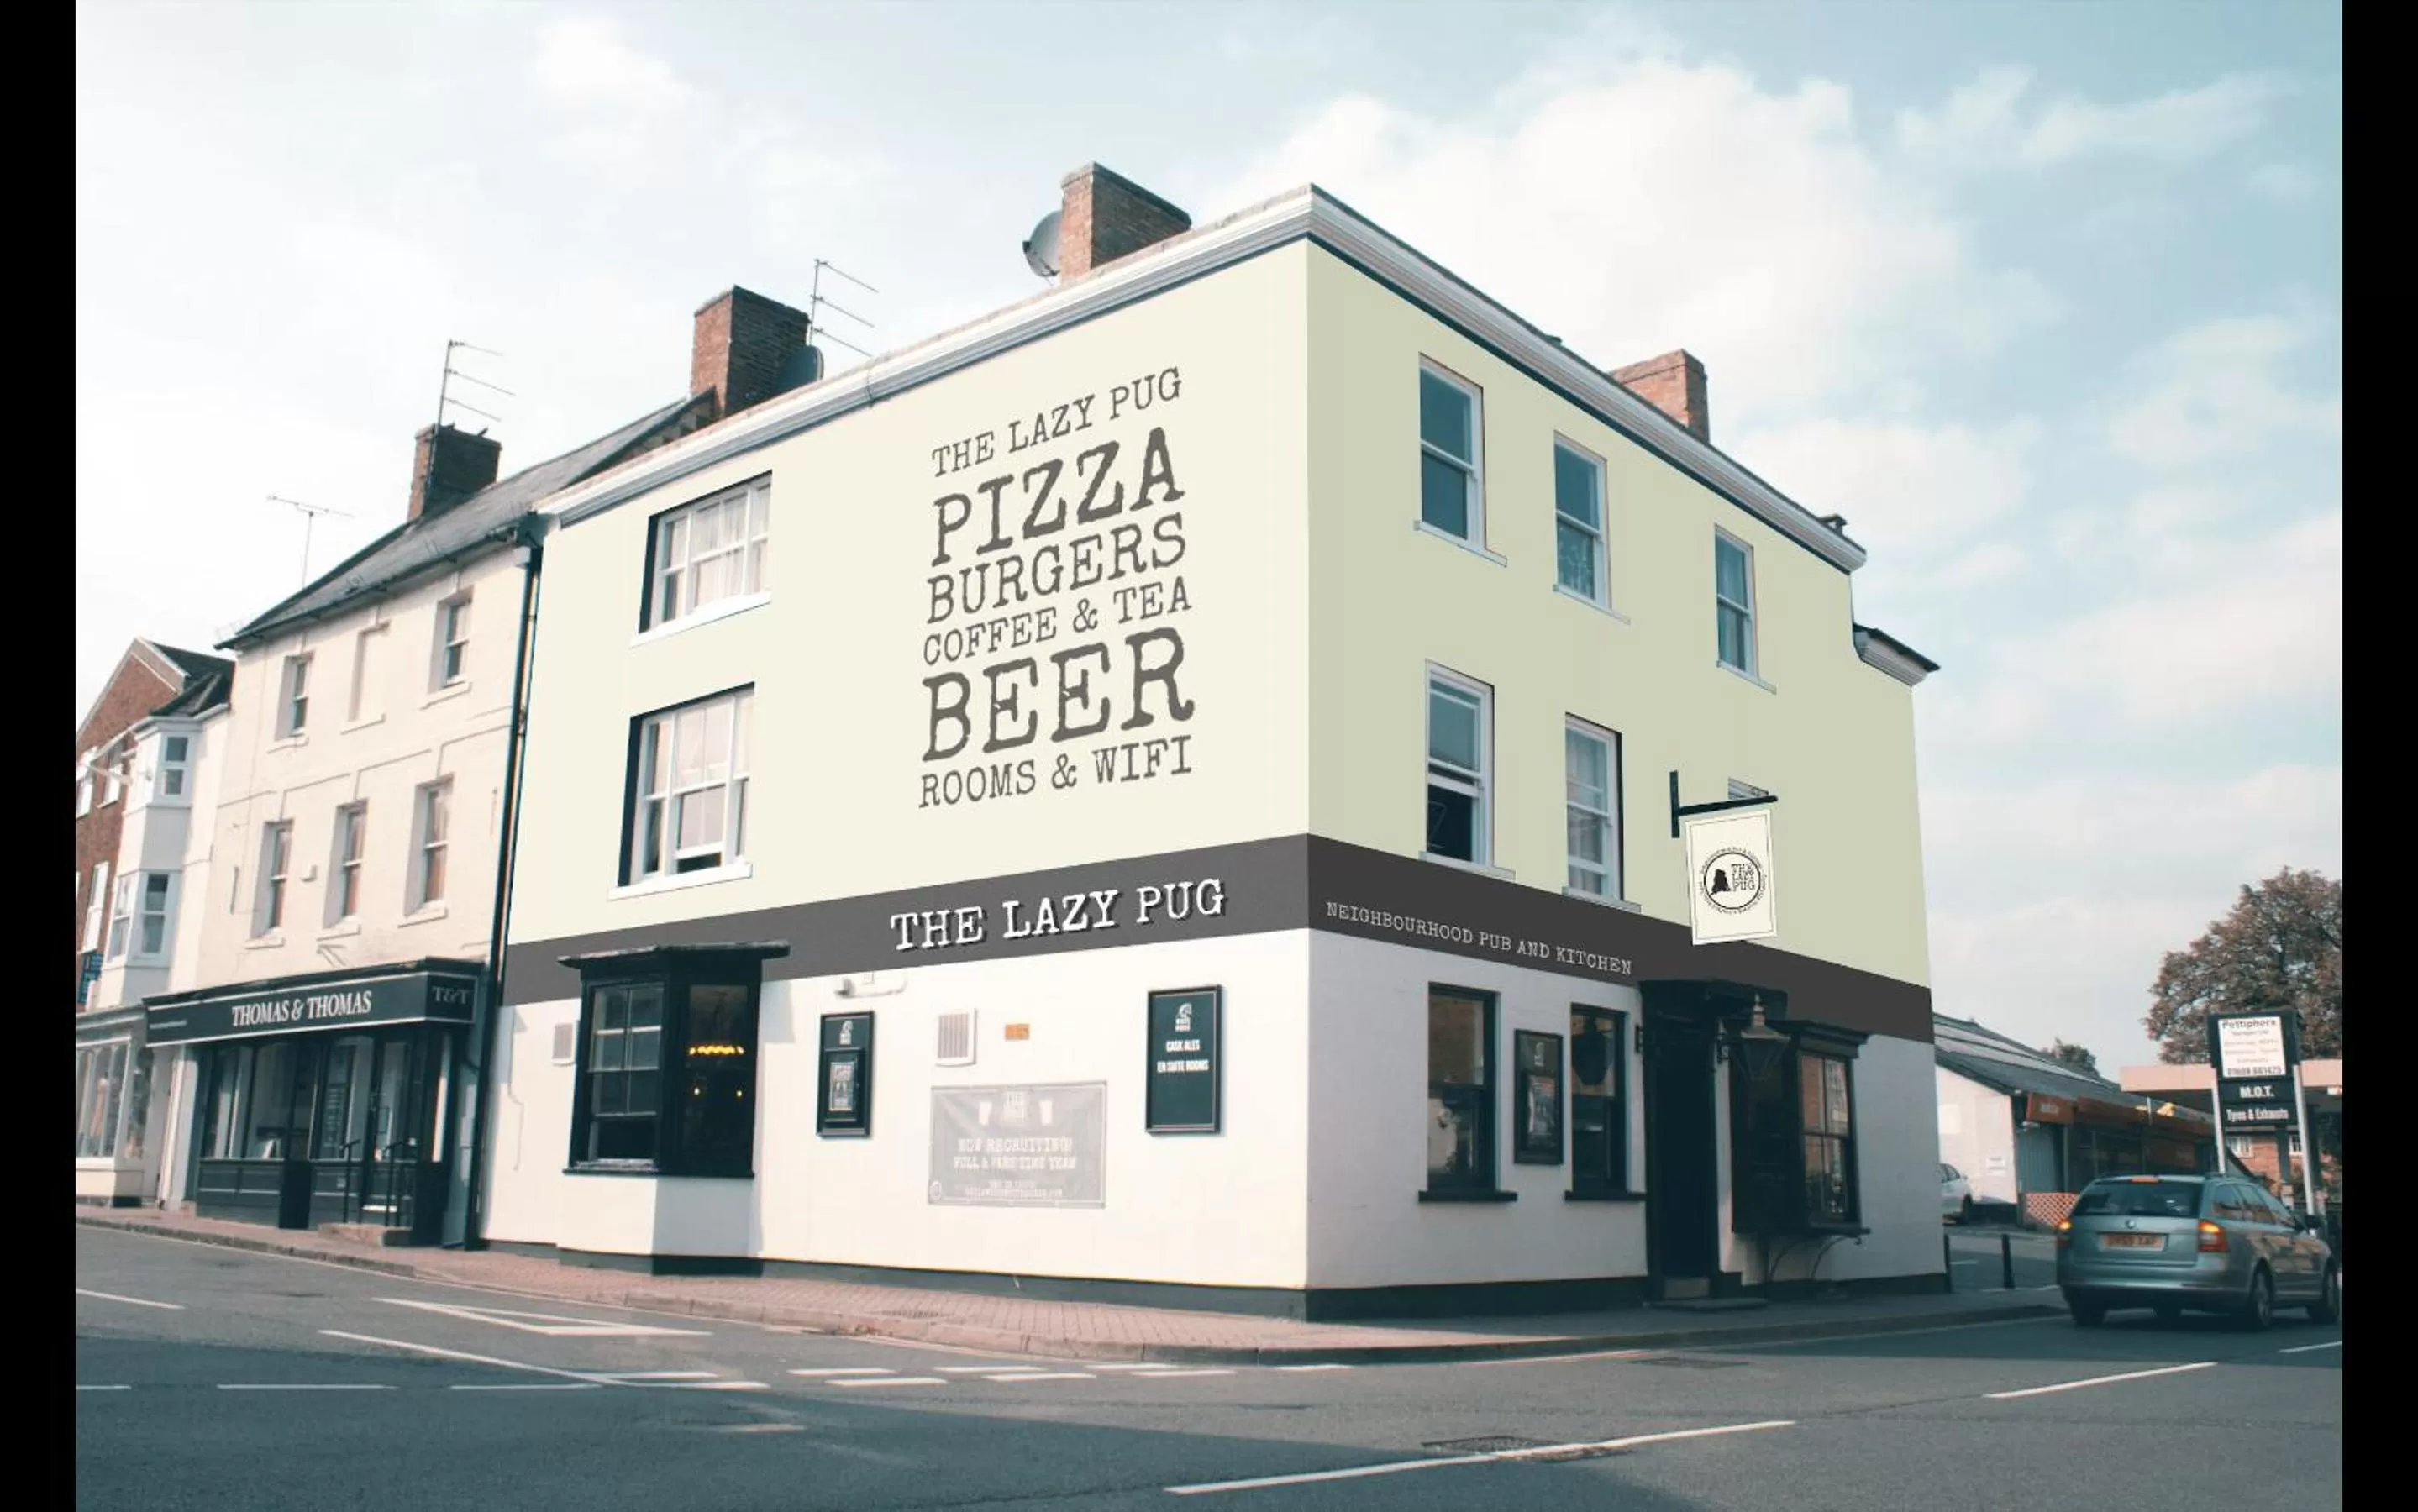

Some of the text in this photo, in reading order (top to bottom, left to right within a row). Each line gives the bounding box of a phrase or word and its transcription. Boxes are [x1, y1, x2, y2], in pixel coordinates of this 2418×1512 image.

[932, 366, 1182, 477] THE LAZY PUG
[932, 427, 1185, 567] PIZZA
[927, 512, 1186, 624] BURGERS
[923, 576, 1192, 665] COFFEE & TEA
[922, 627, 1195, 762] BEER
[919, 735, 1192, 808] ROOMS & WIFI
[891, 879, 1225, 951] THE LAZY PUG
[1732, 879, 1756, 892] PUG
[1327, 901, 1632, 976] NEIGHBOURHOOD PUB AND KITCHEN
[232, 990, 373, 1027] THOMAS & THOMAS
